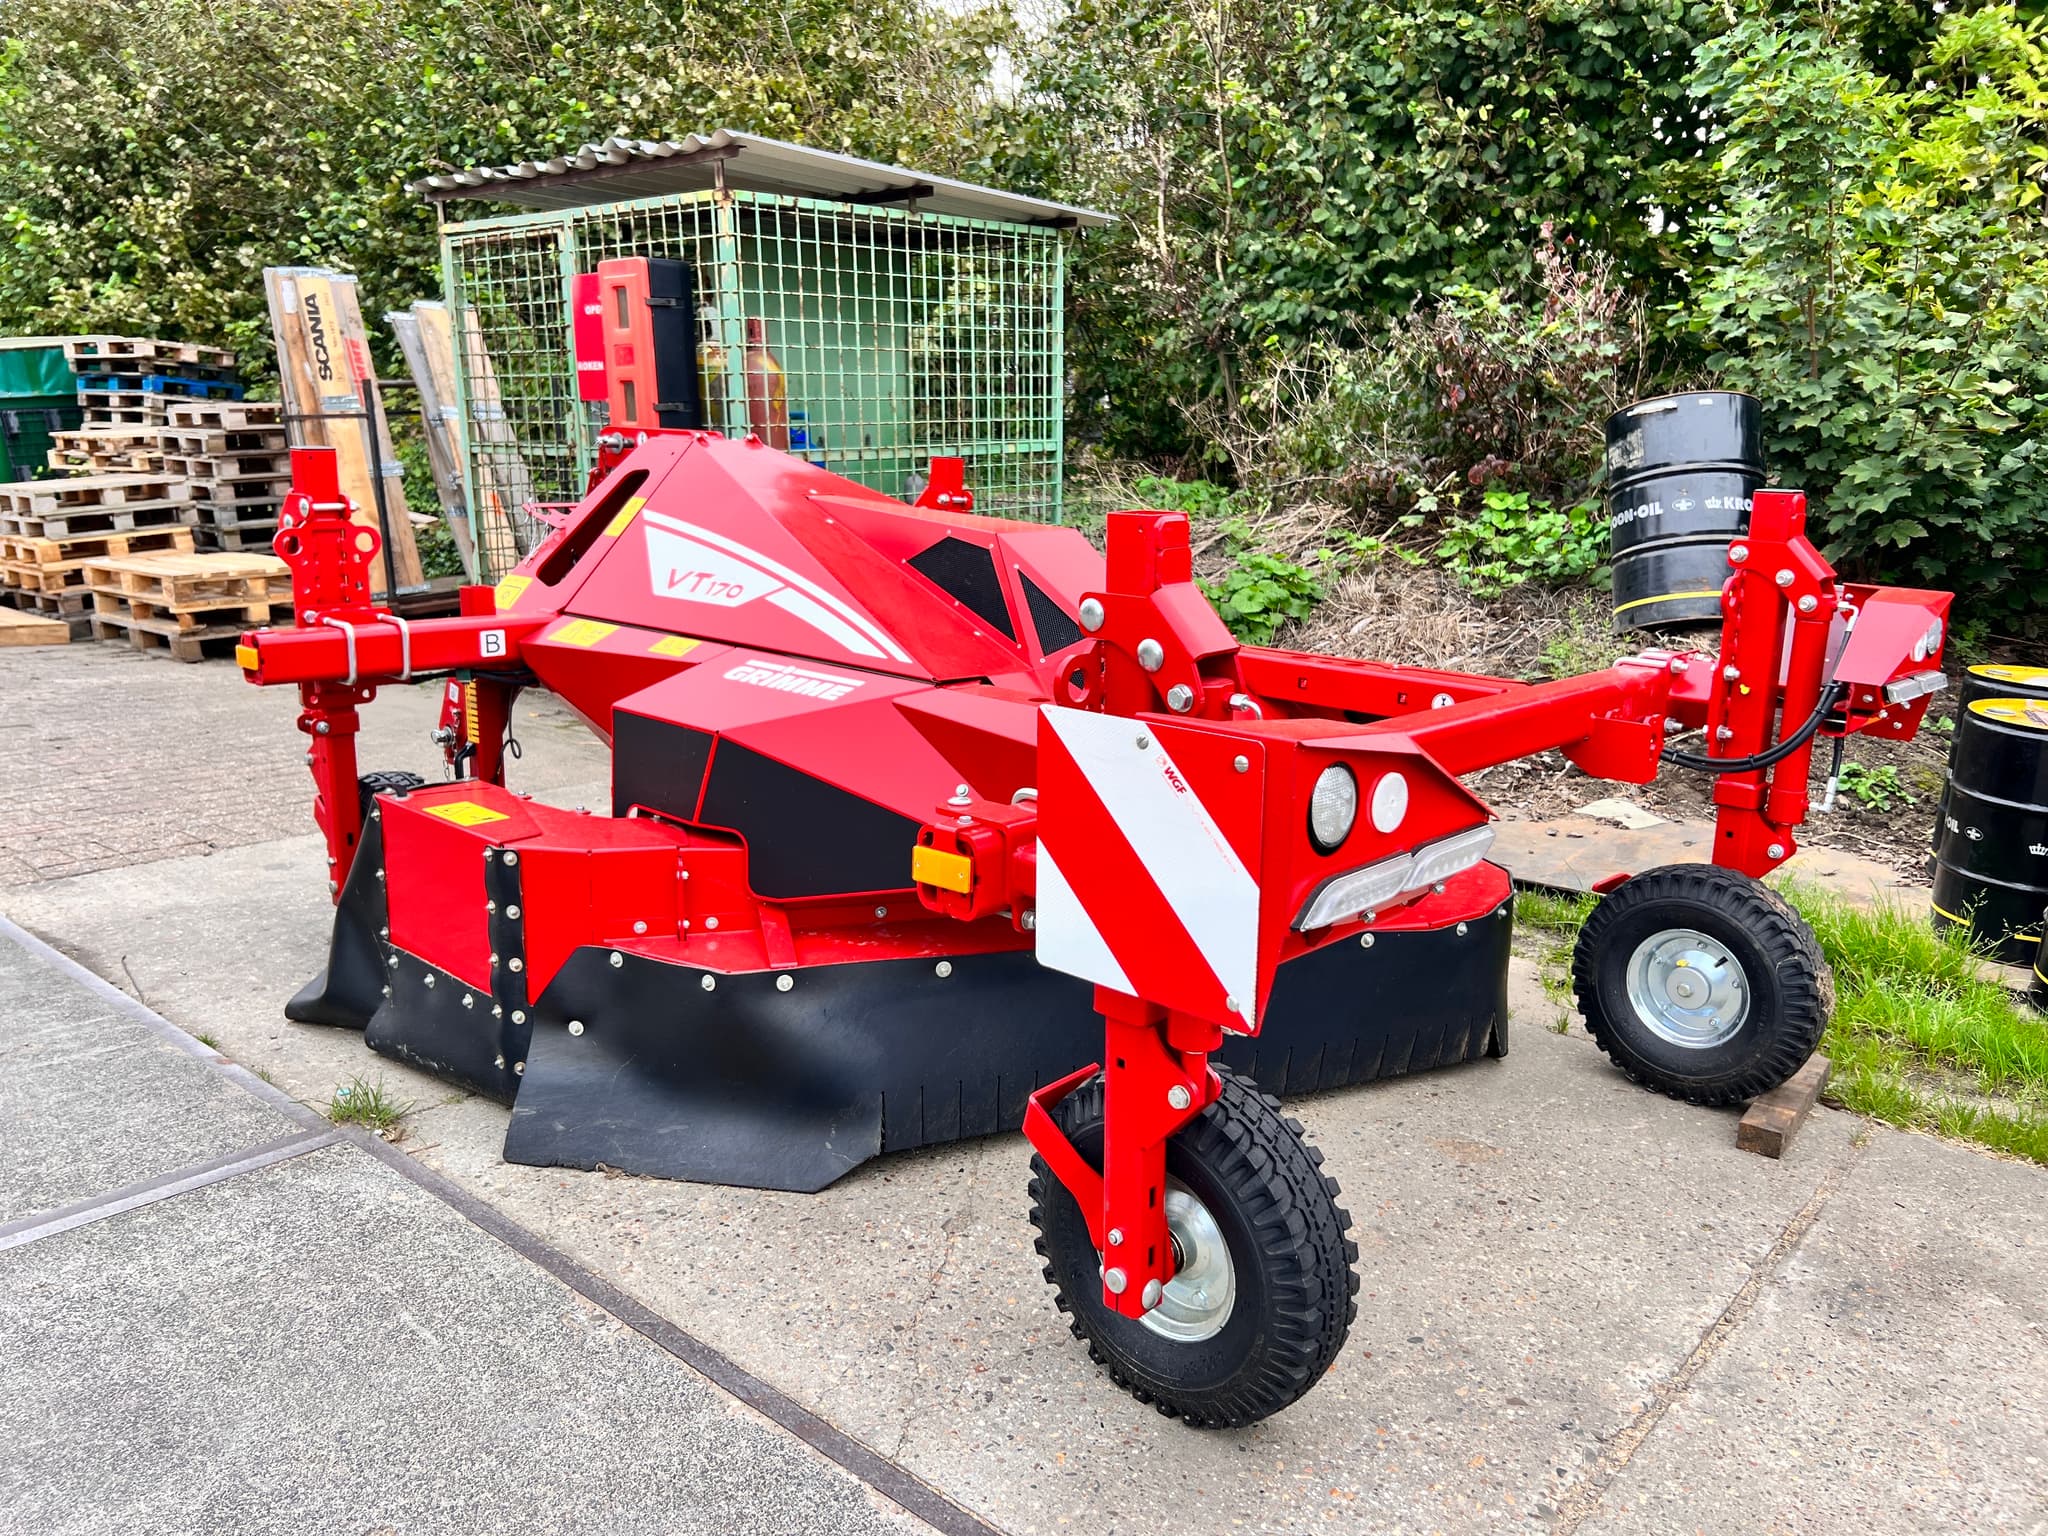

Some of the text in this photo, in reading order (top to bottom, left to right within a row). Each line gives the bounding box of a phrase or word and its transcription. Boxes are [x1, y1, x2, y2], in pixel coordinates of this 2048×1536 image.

[305, 292, 333, 381] SCANIA
[485, 633, 501, 654] B
[723, 662, 858, 702] GRIMME
[1163, 766, 1188, 794] WGF
